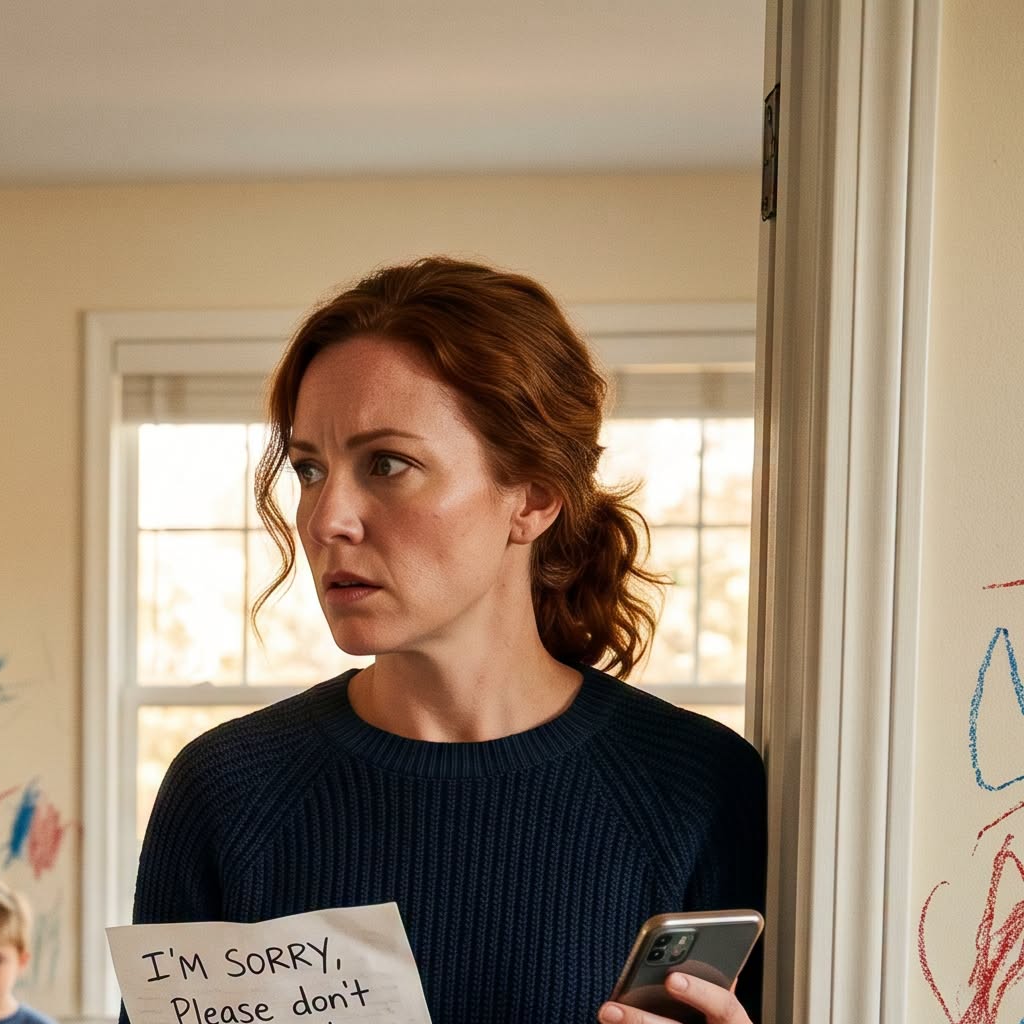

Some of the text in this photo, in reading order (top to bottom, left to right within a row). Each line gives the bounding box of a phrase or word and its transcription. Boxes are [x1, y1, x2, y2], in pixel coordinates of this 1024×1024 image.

[142, 937, 342, 983] I'M SORRY,
[292, 979, 370, 1016] don't
